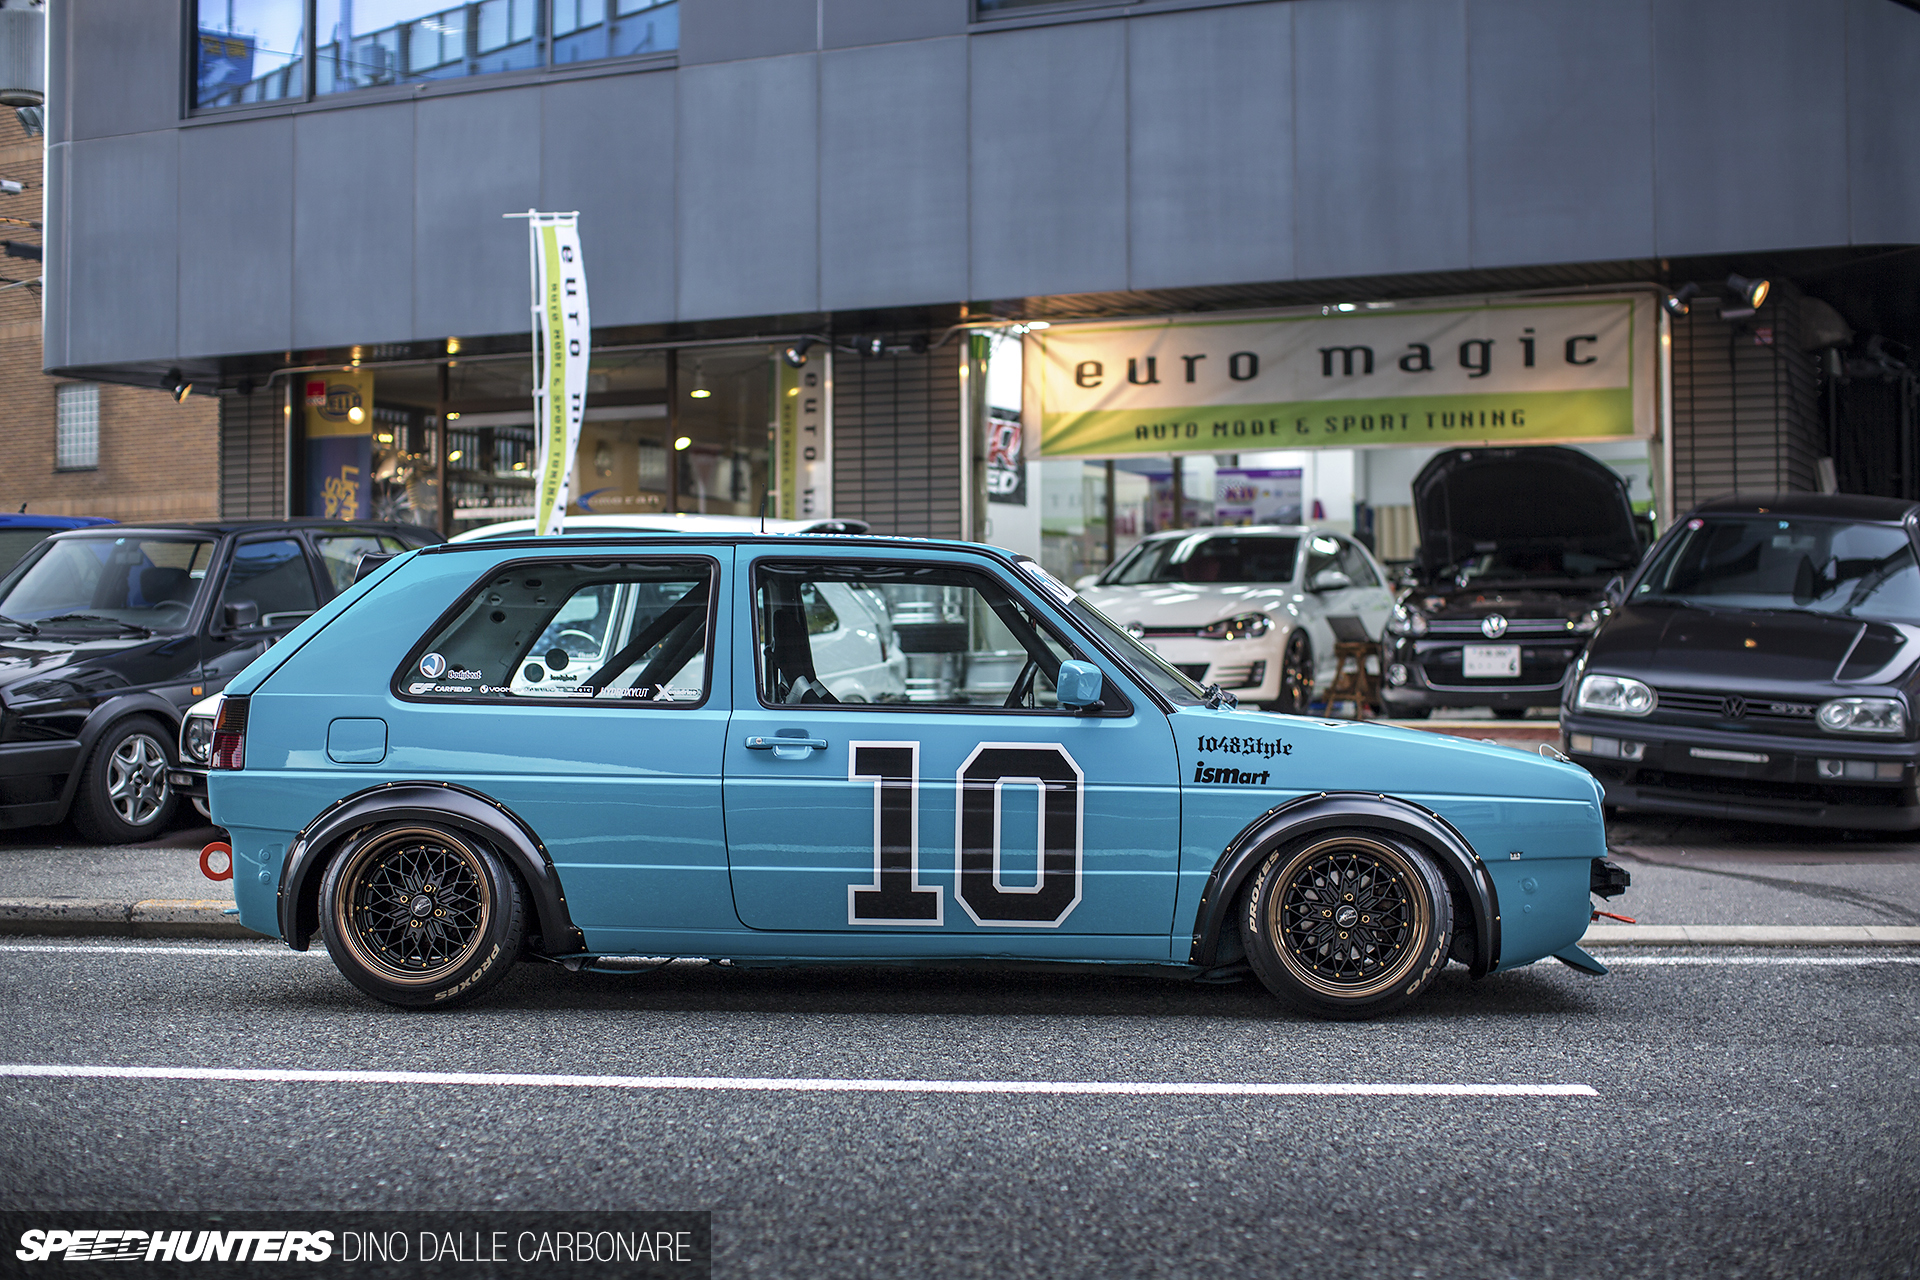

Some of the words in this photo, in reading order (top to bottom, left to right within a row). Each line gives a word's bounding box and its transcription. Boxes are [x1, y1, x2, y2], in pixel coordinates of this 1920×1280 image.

[562, 245, 580, 357] euro
[1075, 350, 1260, 389] euro
[1318, 327, 1598, 379] magic
[1135, 421, 1199, 440] AUTO
[1213, 418, 1280, 438] MODE
[1296, 416, 1310, 435] &
[1324, 411, 1410, 433] SPORT
[1425, 408, 1526, 430] TUNING
[1194, 761, 1271, 785] ismart
[848, 740, 1085, 929] 10
[1249, 849, 1280, 934] PROXES
[433, 943, 501, 1001] PROXES
